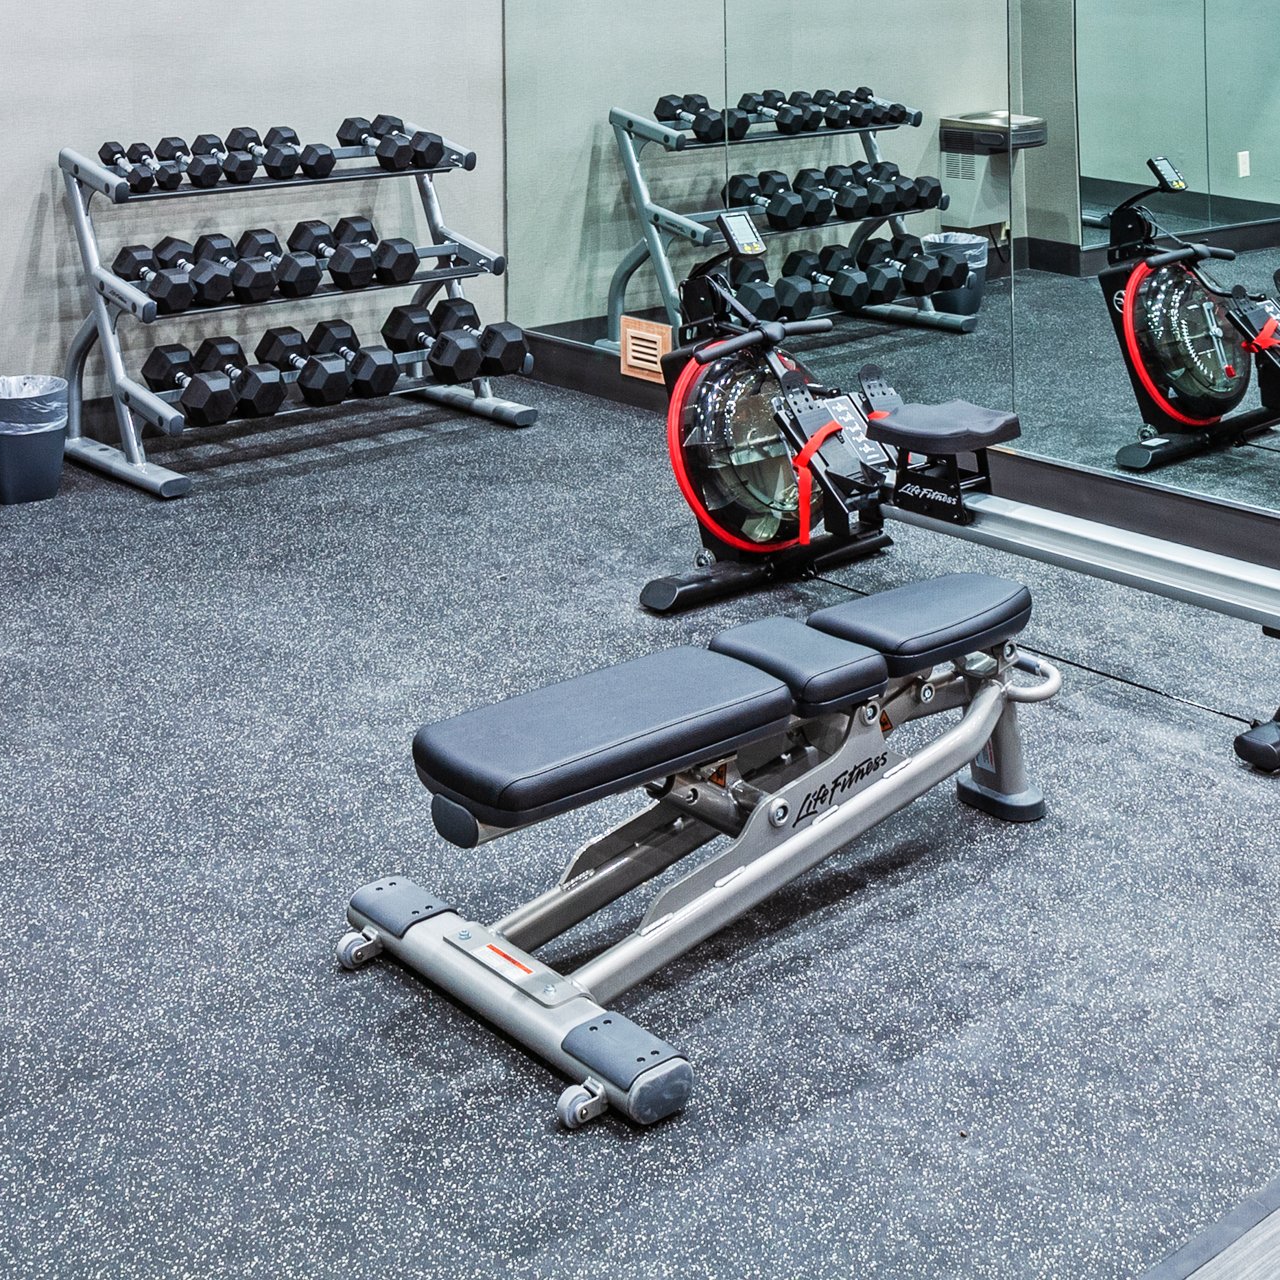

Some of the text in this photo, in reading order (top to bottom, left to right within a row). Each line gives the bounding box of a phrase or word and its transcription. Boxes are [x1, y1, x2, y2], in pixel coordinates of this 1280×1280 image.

[898, 483, 958, 505] Life Fitness
[792, 751, 888, 828] Life Fitness
